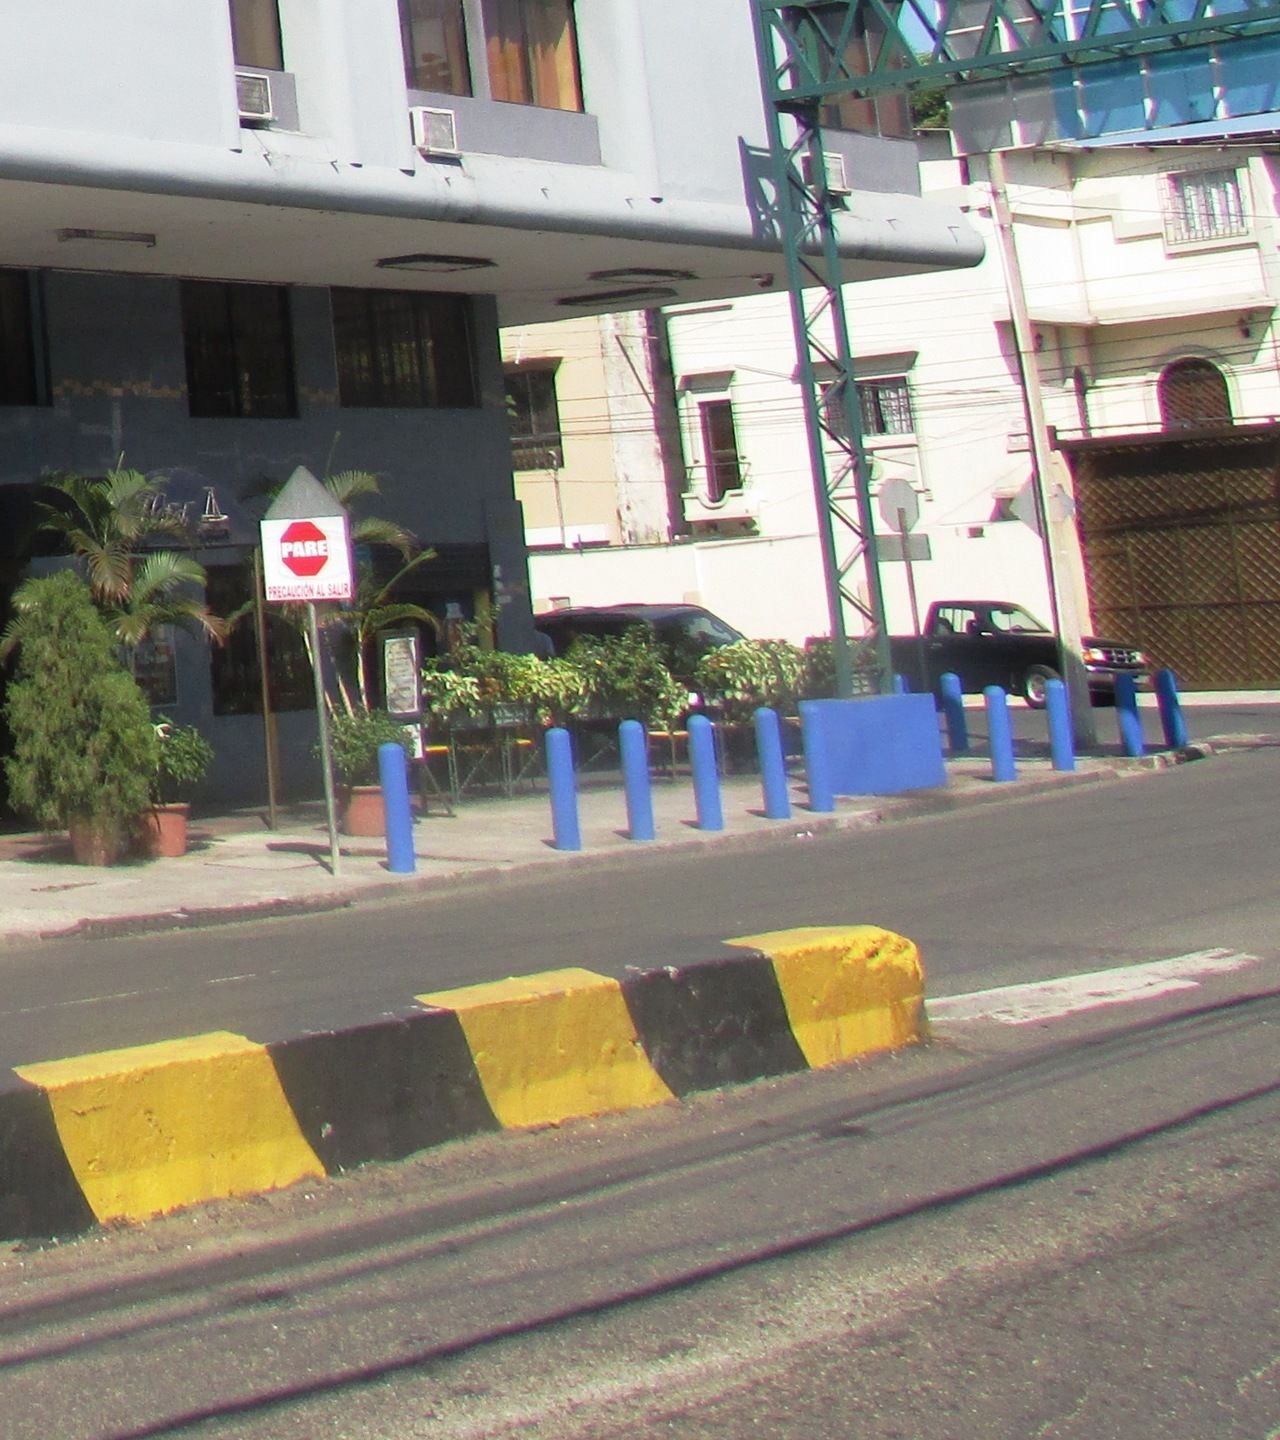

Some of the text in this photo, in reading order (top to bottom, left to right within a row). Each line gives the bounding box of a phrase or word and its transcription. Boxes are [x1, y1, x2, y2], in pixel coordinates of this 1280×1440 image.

[281, 540, 329, 558] PARE
[316, 584, 326, 597] AL
[328, 583, 349, 596] SALIR
